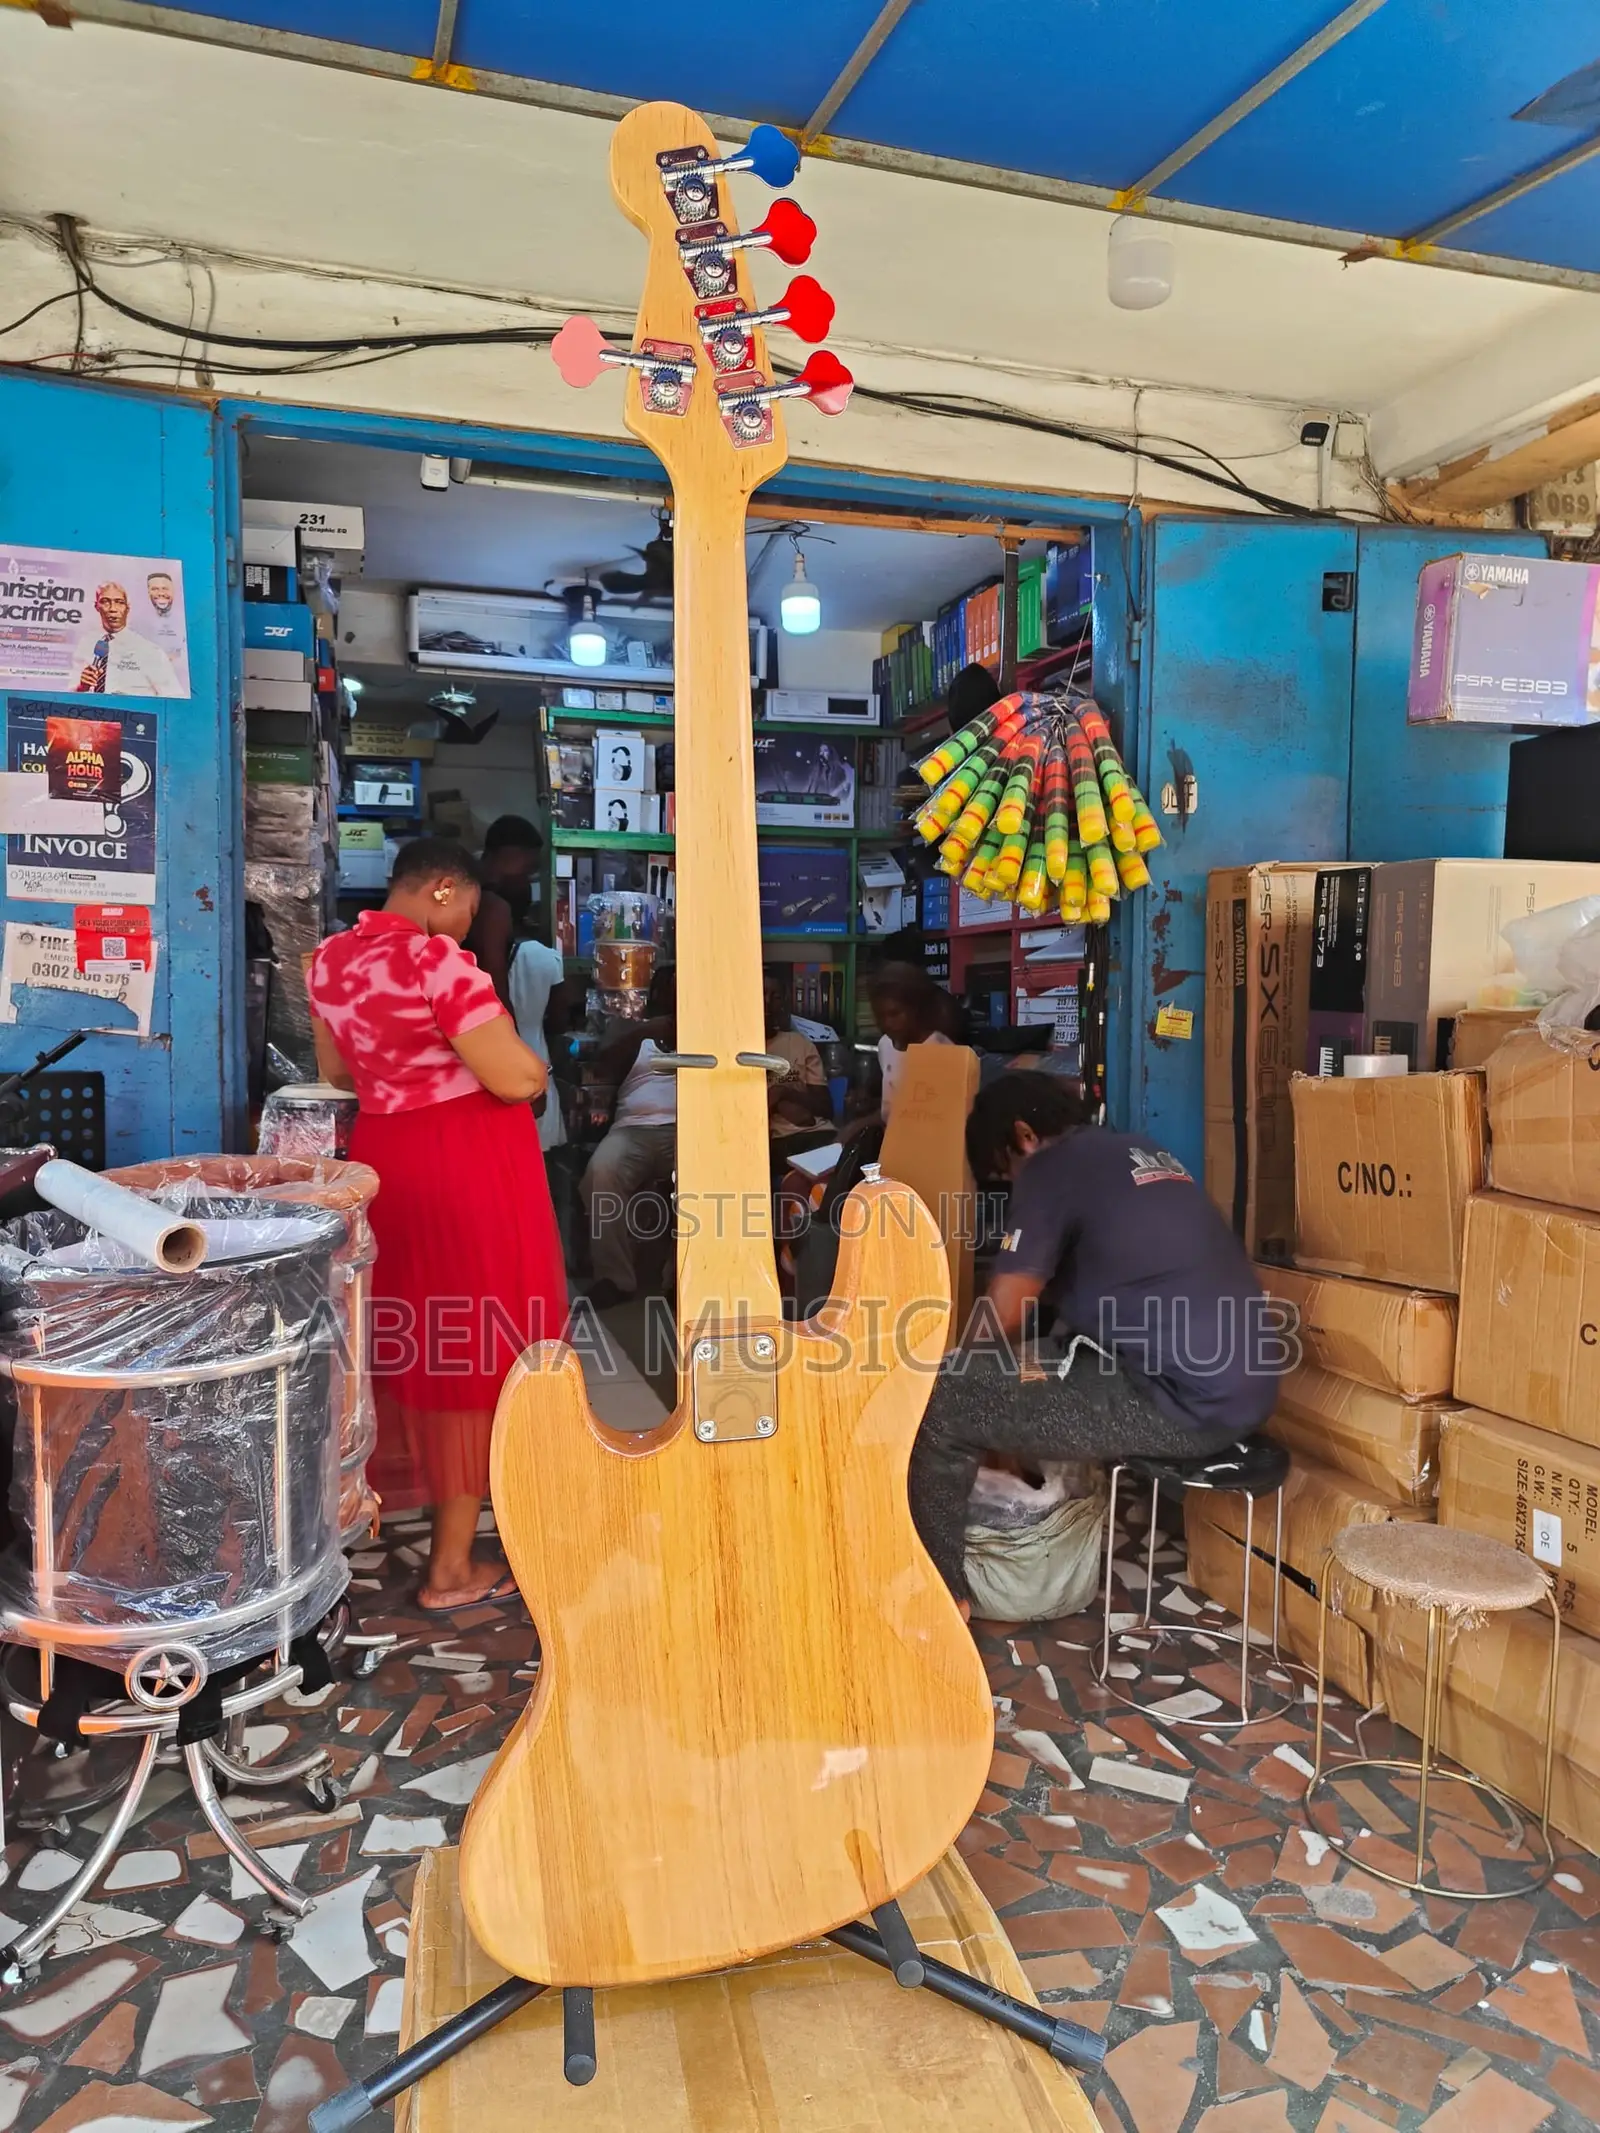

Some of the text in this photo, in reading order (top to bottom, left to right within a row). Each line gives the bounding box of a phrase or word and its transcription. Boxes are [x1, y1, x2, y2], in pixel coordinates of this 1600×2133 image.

[299, 513, 326, 525] 231
[1481, 565, 1529, 585] YAMAHA
[1419, 621, 1435, 679] YAMAHA
[1453, 674, 1568, 695] PSR-E383
[65, 751, 104, 767] ALPHA
[67, 764, 103, 779] HOUR
[24, 833, 127, 860] INVOICE
[1316, 876, 1328, 968] PSR-E473
[40, 935, 70, 951] FIRE
[1235, 926, 1245, 987] YAMAHA
[32, 962, 70, 979] 0302
[1585, 1484, 1599, 1542] MODEL:
[1566, 1542, 1578, 1554] 5
